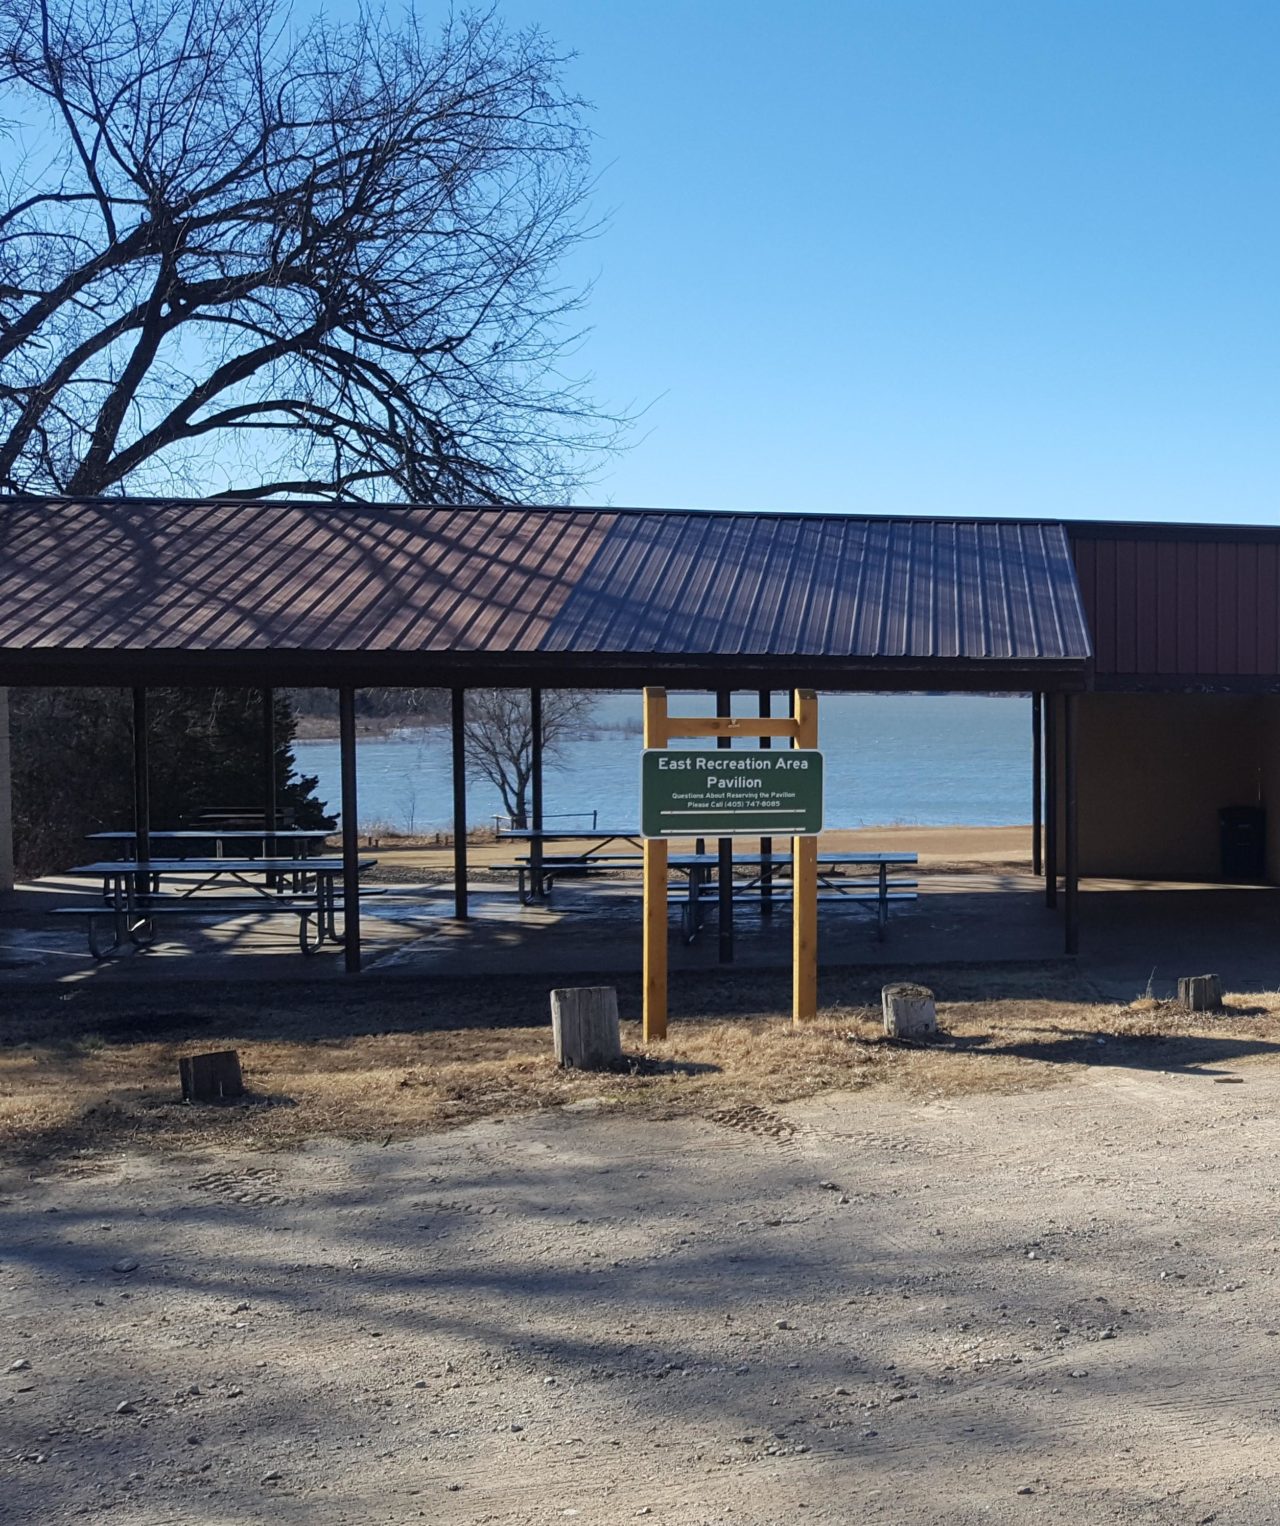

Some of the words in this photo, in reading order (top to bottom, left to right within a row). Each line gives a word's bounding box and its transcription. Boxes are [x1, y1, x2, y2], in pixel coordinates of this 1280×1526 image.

[658, 757, 692, 770] East
[696, 757, 771, 770] Recreation
[775, 757, 809, 770] Area
[707, 776, 762, 789] Pavilion
